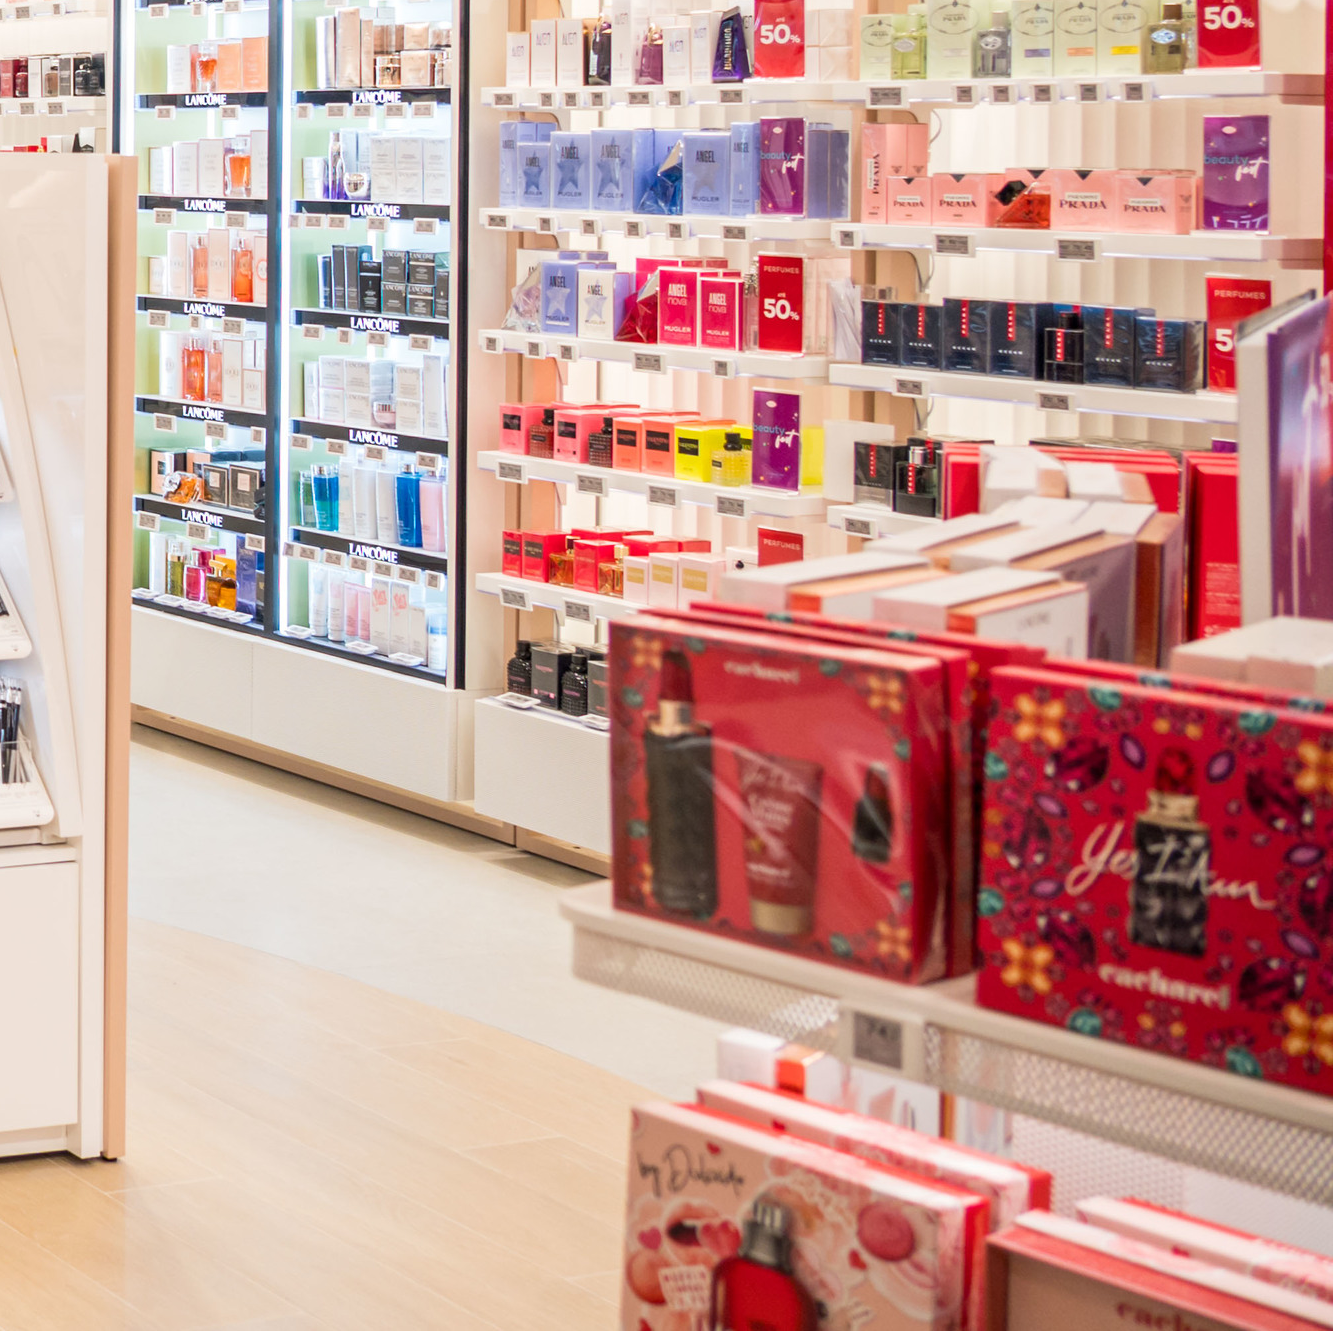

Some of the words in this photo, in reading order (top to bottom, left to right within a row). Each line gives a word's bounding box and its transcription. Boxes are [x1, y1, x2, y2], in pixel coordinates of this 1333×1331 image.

[1203, 5, 1254, 30] 50%
[760, 24, 800, 45] 50%
[185, 92, 227, 106] LANCÔME
[352, 89, 402, 104] LANCÔME
[560, 145, 579, 160] ANGEL
[600, 144, 620, 158] ANGEL
[733, 141, 749, 153] ANGEL
[696, 150, 715, 163] ANGEL
[1203, 154, 1249, 166] beauty
[557, 190, 582, 198] MUGLER
[597, 192, 624, 200] MUGLER
[691, 195, 720, 203] MUGLER
[184, 197, 226, 211] LANCÔME
[351, 202, 400, 218] LANCÔME
[893, 200, 925, 208] PRADA
[939, 200, 977, 208] PRADA
[1059, 199, 1107, 210] PRADA
[1124, 204, 1166, 213] PRADA
[763, 265, 799, 274] PERFUMES
[549, 275, 567, 287] ANGEL
[586, 284, 603, 296] ANGEL
[668, 282, 687, 297] ANGEL
[1214, 289, 1266, 300] PERFUMES
[708, 292, 727, 305] ANGEL
[183, 301, 225, 317] LANCÔME
[763, 299, 799, 321] 50%
[350, 316, 399, 333] LANCÔME
[664, 325, 691, 334] MUGLER
[706, 329, 730, 337] MUGLER
[182, 405, 224, 422] LANCÔME
[753, 423, 785, 436] beauty
[349, 430, 398, 448] LANCÔME
[181, 508, 223, 528] LANCÔME
[763, 538, 801, 551] PERFUMES
[348, 541, 397, 563] LANCÔME
[1098, 963, 1231, 1011] cacharel
